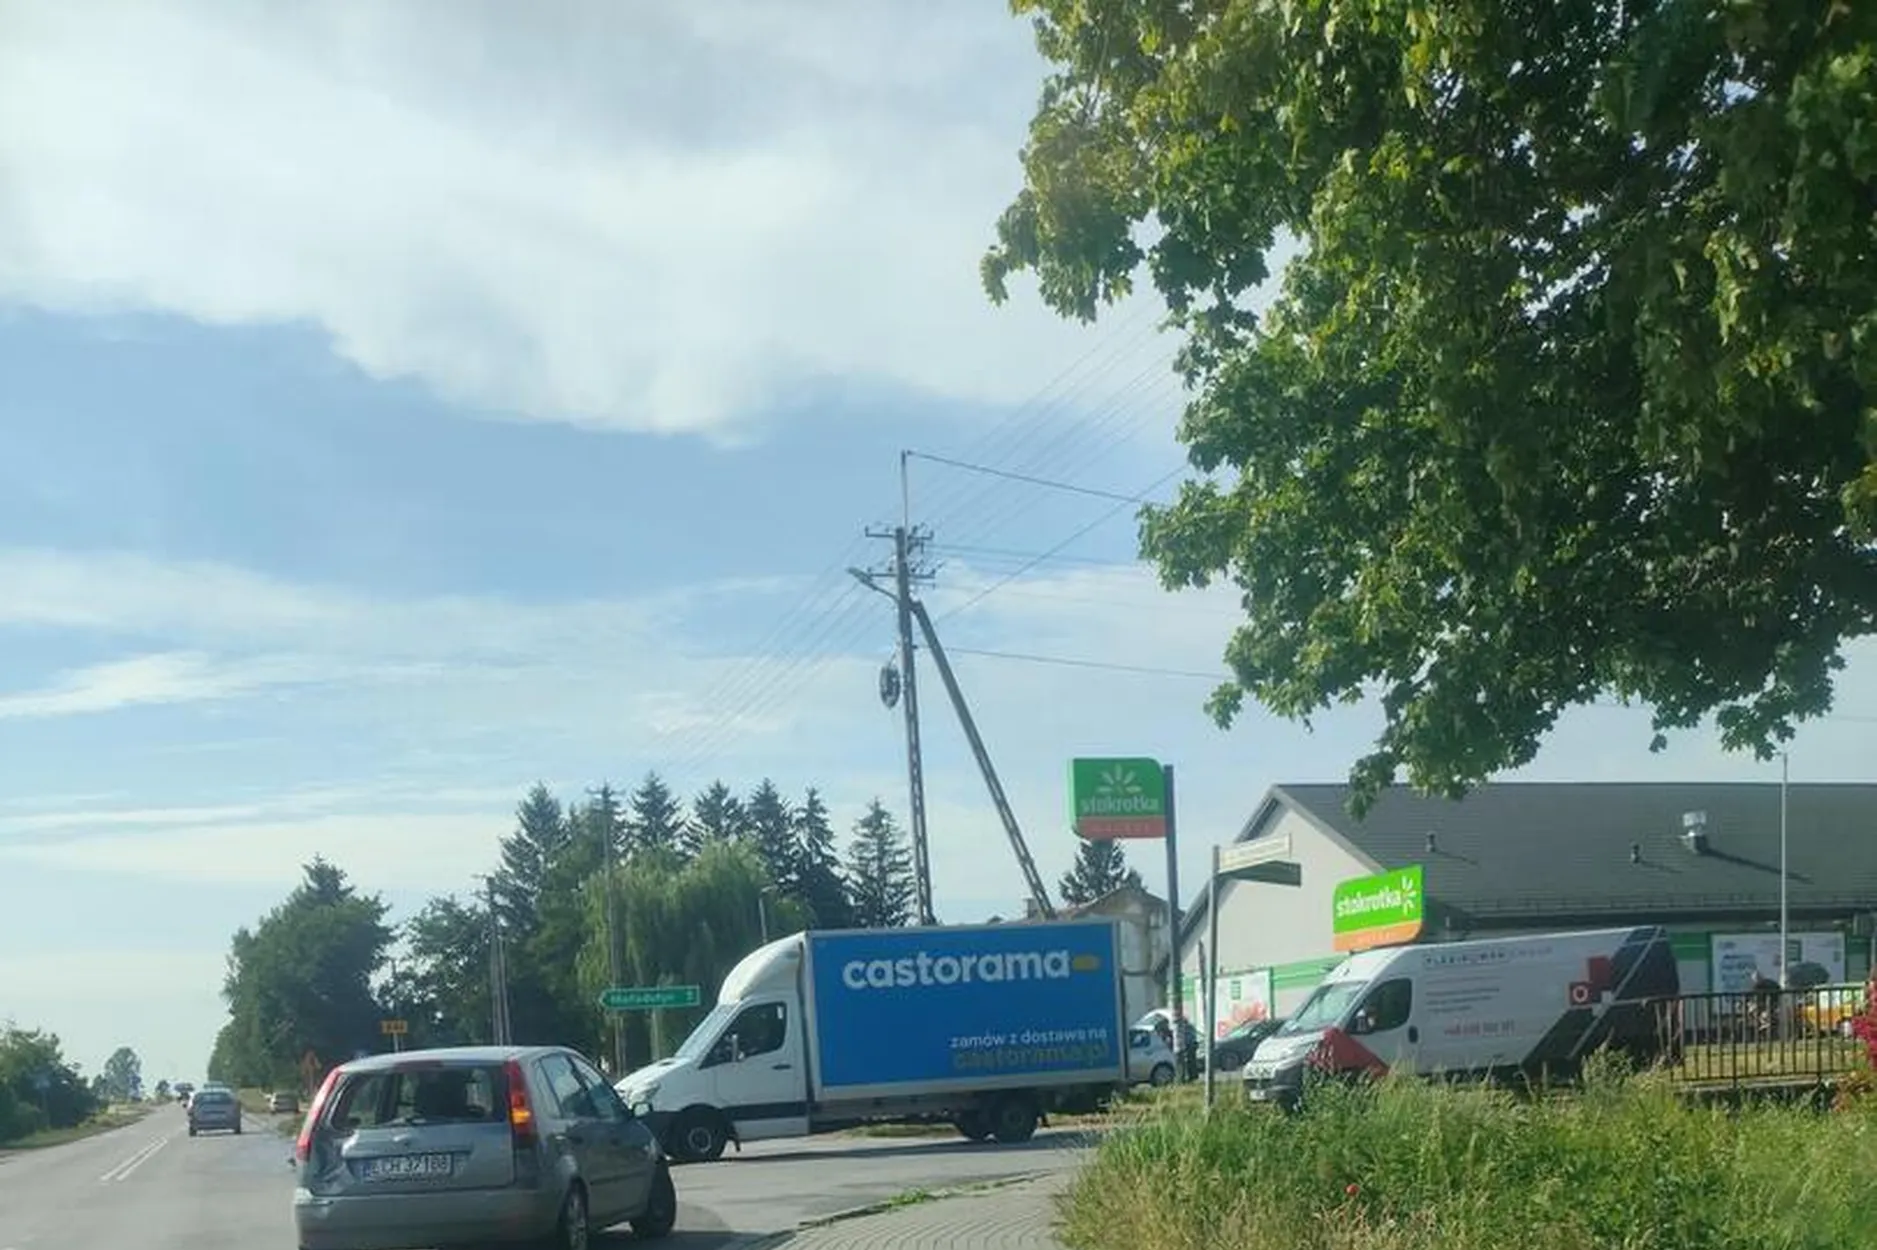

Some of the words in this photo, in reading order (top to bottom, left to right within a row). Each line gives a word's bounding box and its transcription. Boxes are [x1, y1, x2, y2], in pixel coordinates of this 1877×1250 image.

[1335, 884, 1402, 920] stokrotka
[842, 950, 1070, 989] castorama
[950, 1028, 1005, 1047] zamów
[1009, 1032, 1017, 1045] z
[1089, 1028, 1108, 1041] na
